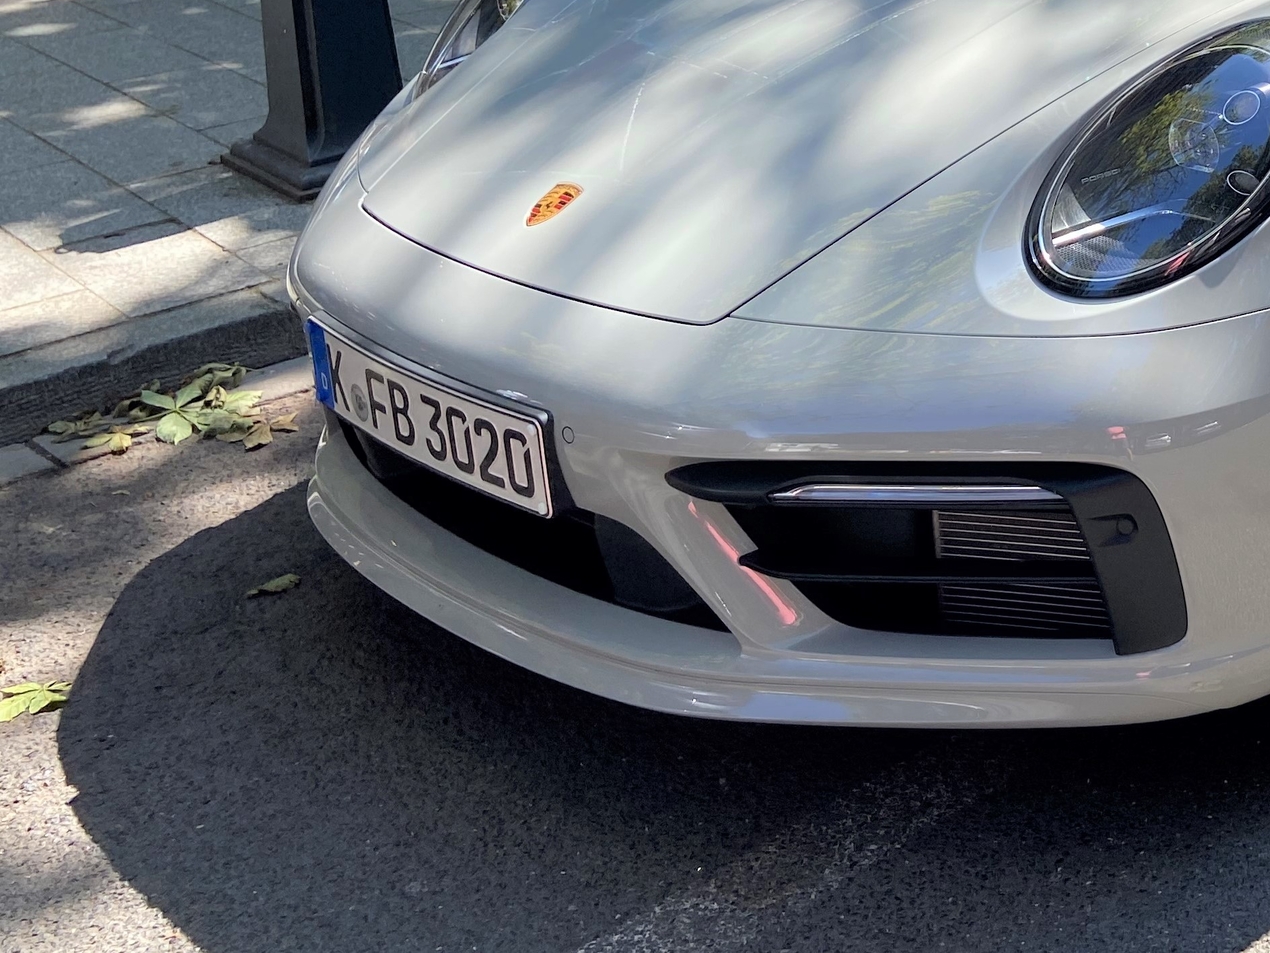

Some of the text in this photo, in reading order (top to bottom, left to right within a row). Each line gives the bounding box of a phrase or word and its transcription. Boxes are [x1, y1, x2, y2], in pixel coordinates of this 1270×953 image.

[327, 344, 535, 498] K FB 3020
